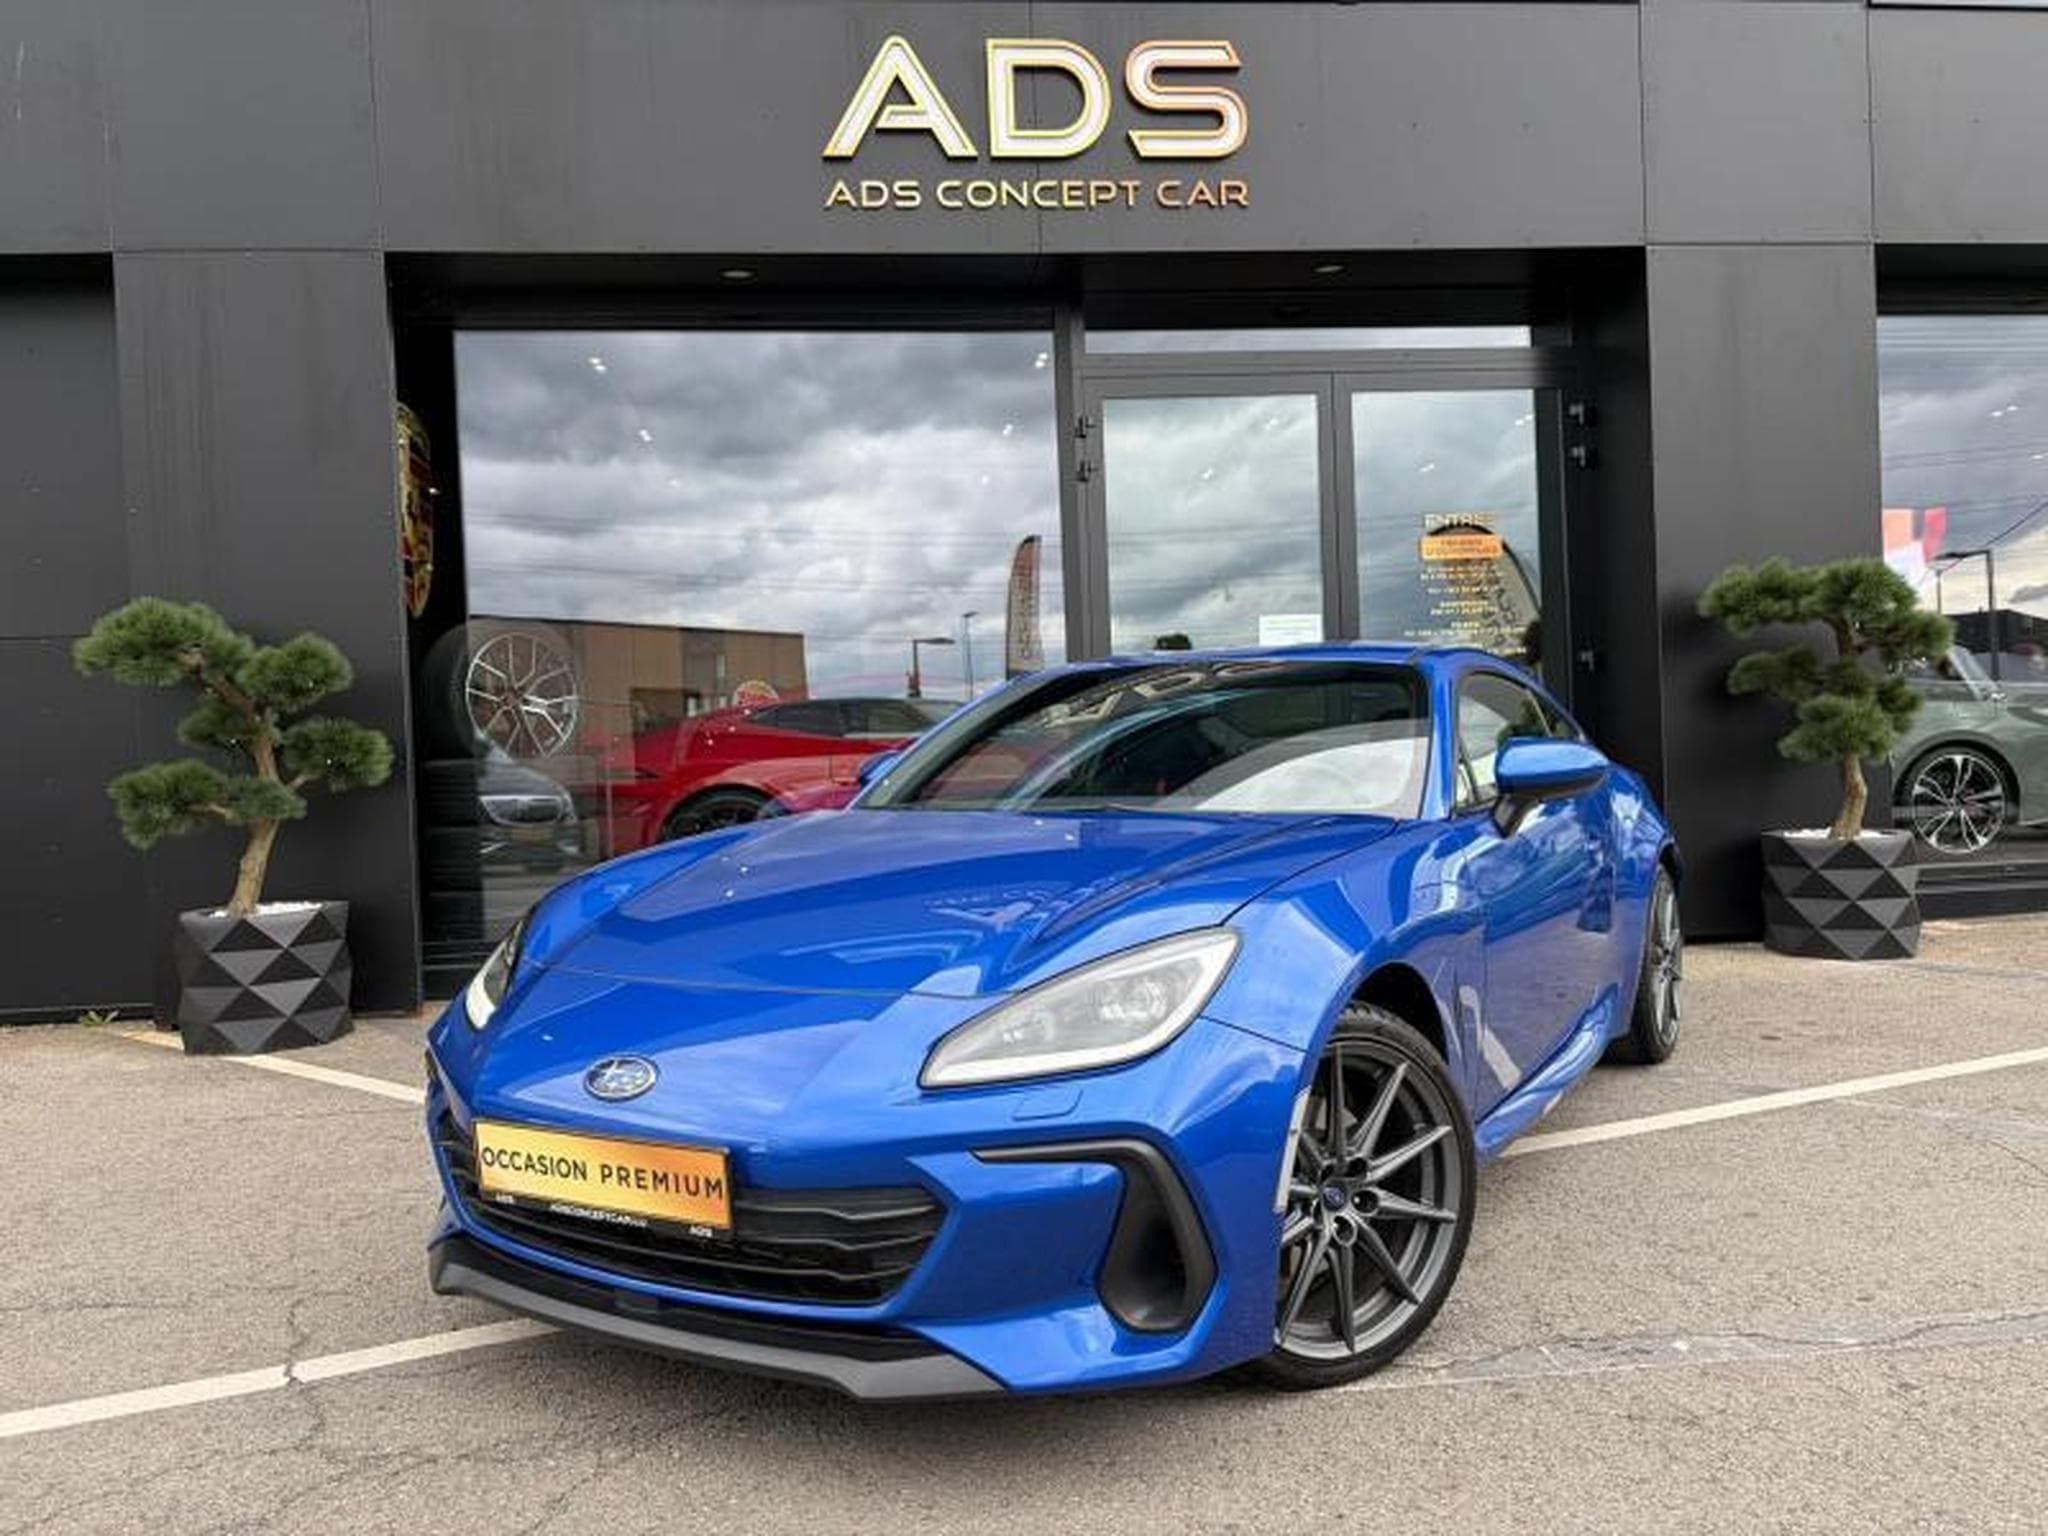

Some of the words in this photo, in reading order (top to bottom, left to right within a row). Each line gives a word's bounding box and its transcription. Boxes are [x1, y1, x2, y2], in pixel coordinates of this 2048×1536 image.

[822, 35, 1250, 160] ADS
[824, 179, 922, 208] ADS
[935, 179, 1141, 208] CONCEPT
[1156, 179, 1250, 208] CAR
[481, 1147, 588, 1181] OCCASION
[600, 1163, 724, 1199] PREMIUM
